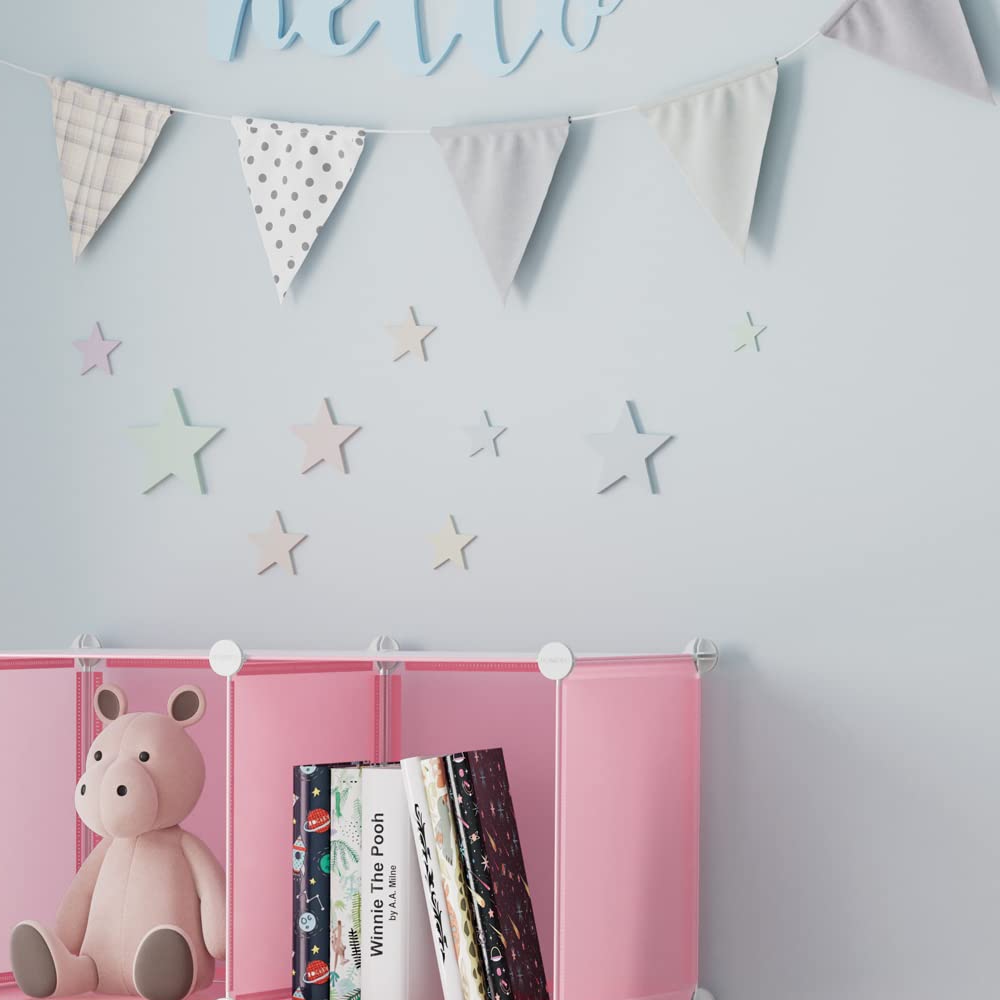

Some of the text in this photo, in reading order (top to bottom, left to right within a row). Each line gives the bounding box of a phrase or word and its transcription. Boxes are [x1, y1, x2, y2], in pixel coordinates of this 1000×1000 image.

[370, 812, 385, 957] Winnie The Pooh
[388, 864, 399, 921] by A.A. Milne
